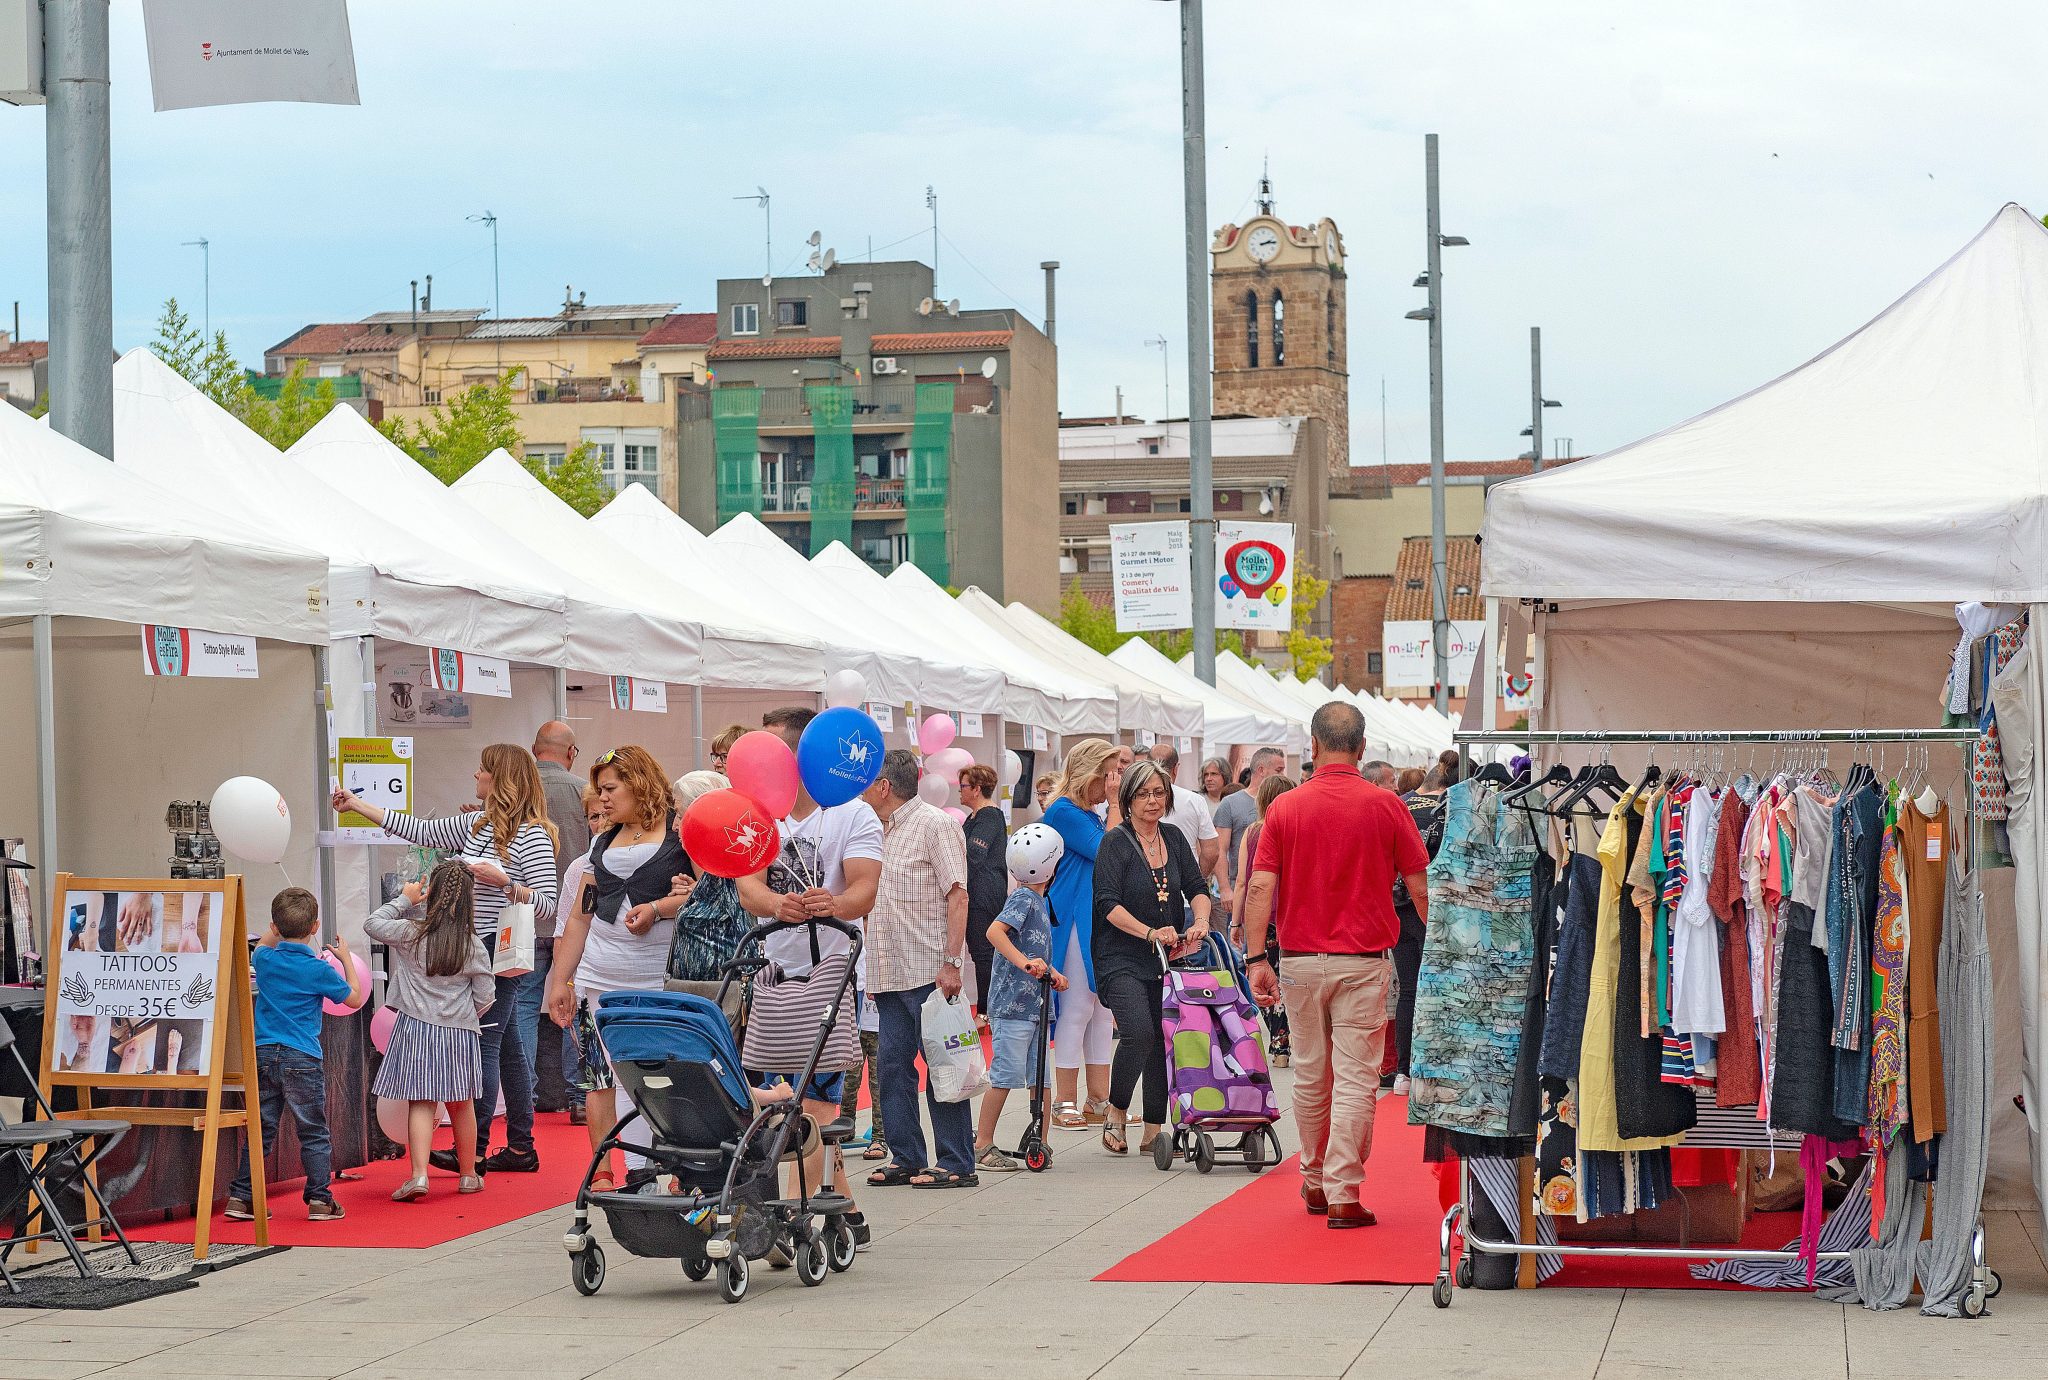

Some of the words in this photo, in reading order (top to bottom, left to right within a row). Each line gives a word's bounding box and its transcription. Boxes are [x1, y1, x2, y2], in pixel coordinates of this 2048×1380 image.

[216, 49, 253, 58] Ajuntament
[263, 47, 282, 55] Mollet
[1241, 556, 1268, 564] Mollet
[1122, 588, 1152, 596] Qualitat
[156, 628, 178, 642] Mollet
[203, 643, 218, 655] Tattoo
[218, 644, 230, 658] Style
[230, 644, 246, 656] Mollet
[388, 778, 403, 794] G
[100, 955, 178, 972] TATTOOS
[94, 978, 181, 991] PERMANENTES
[95, 1004, 134, 1016] DESDE
[138, 997, 177, 1017] 35€
